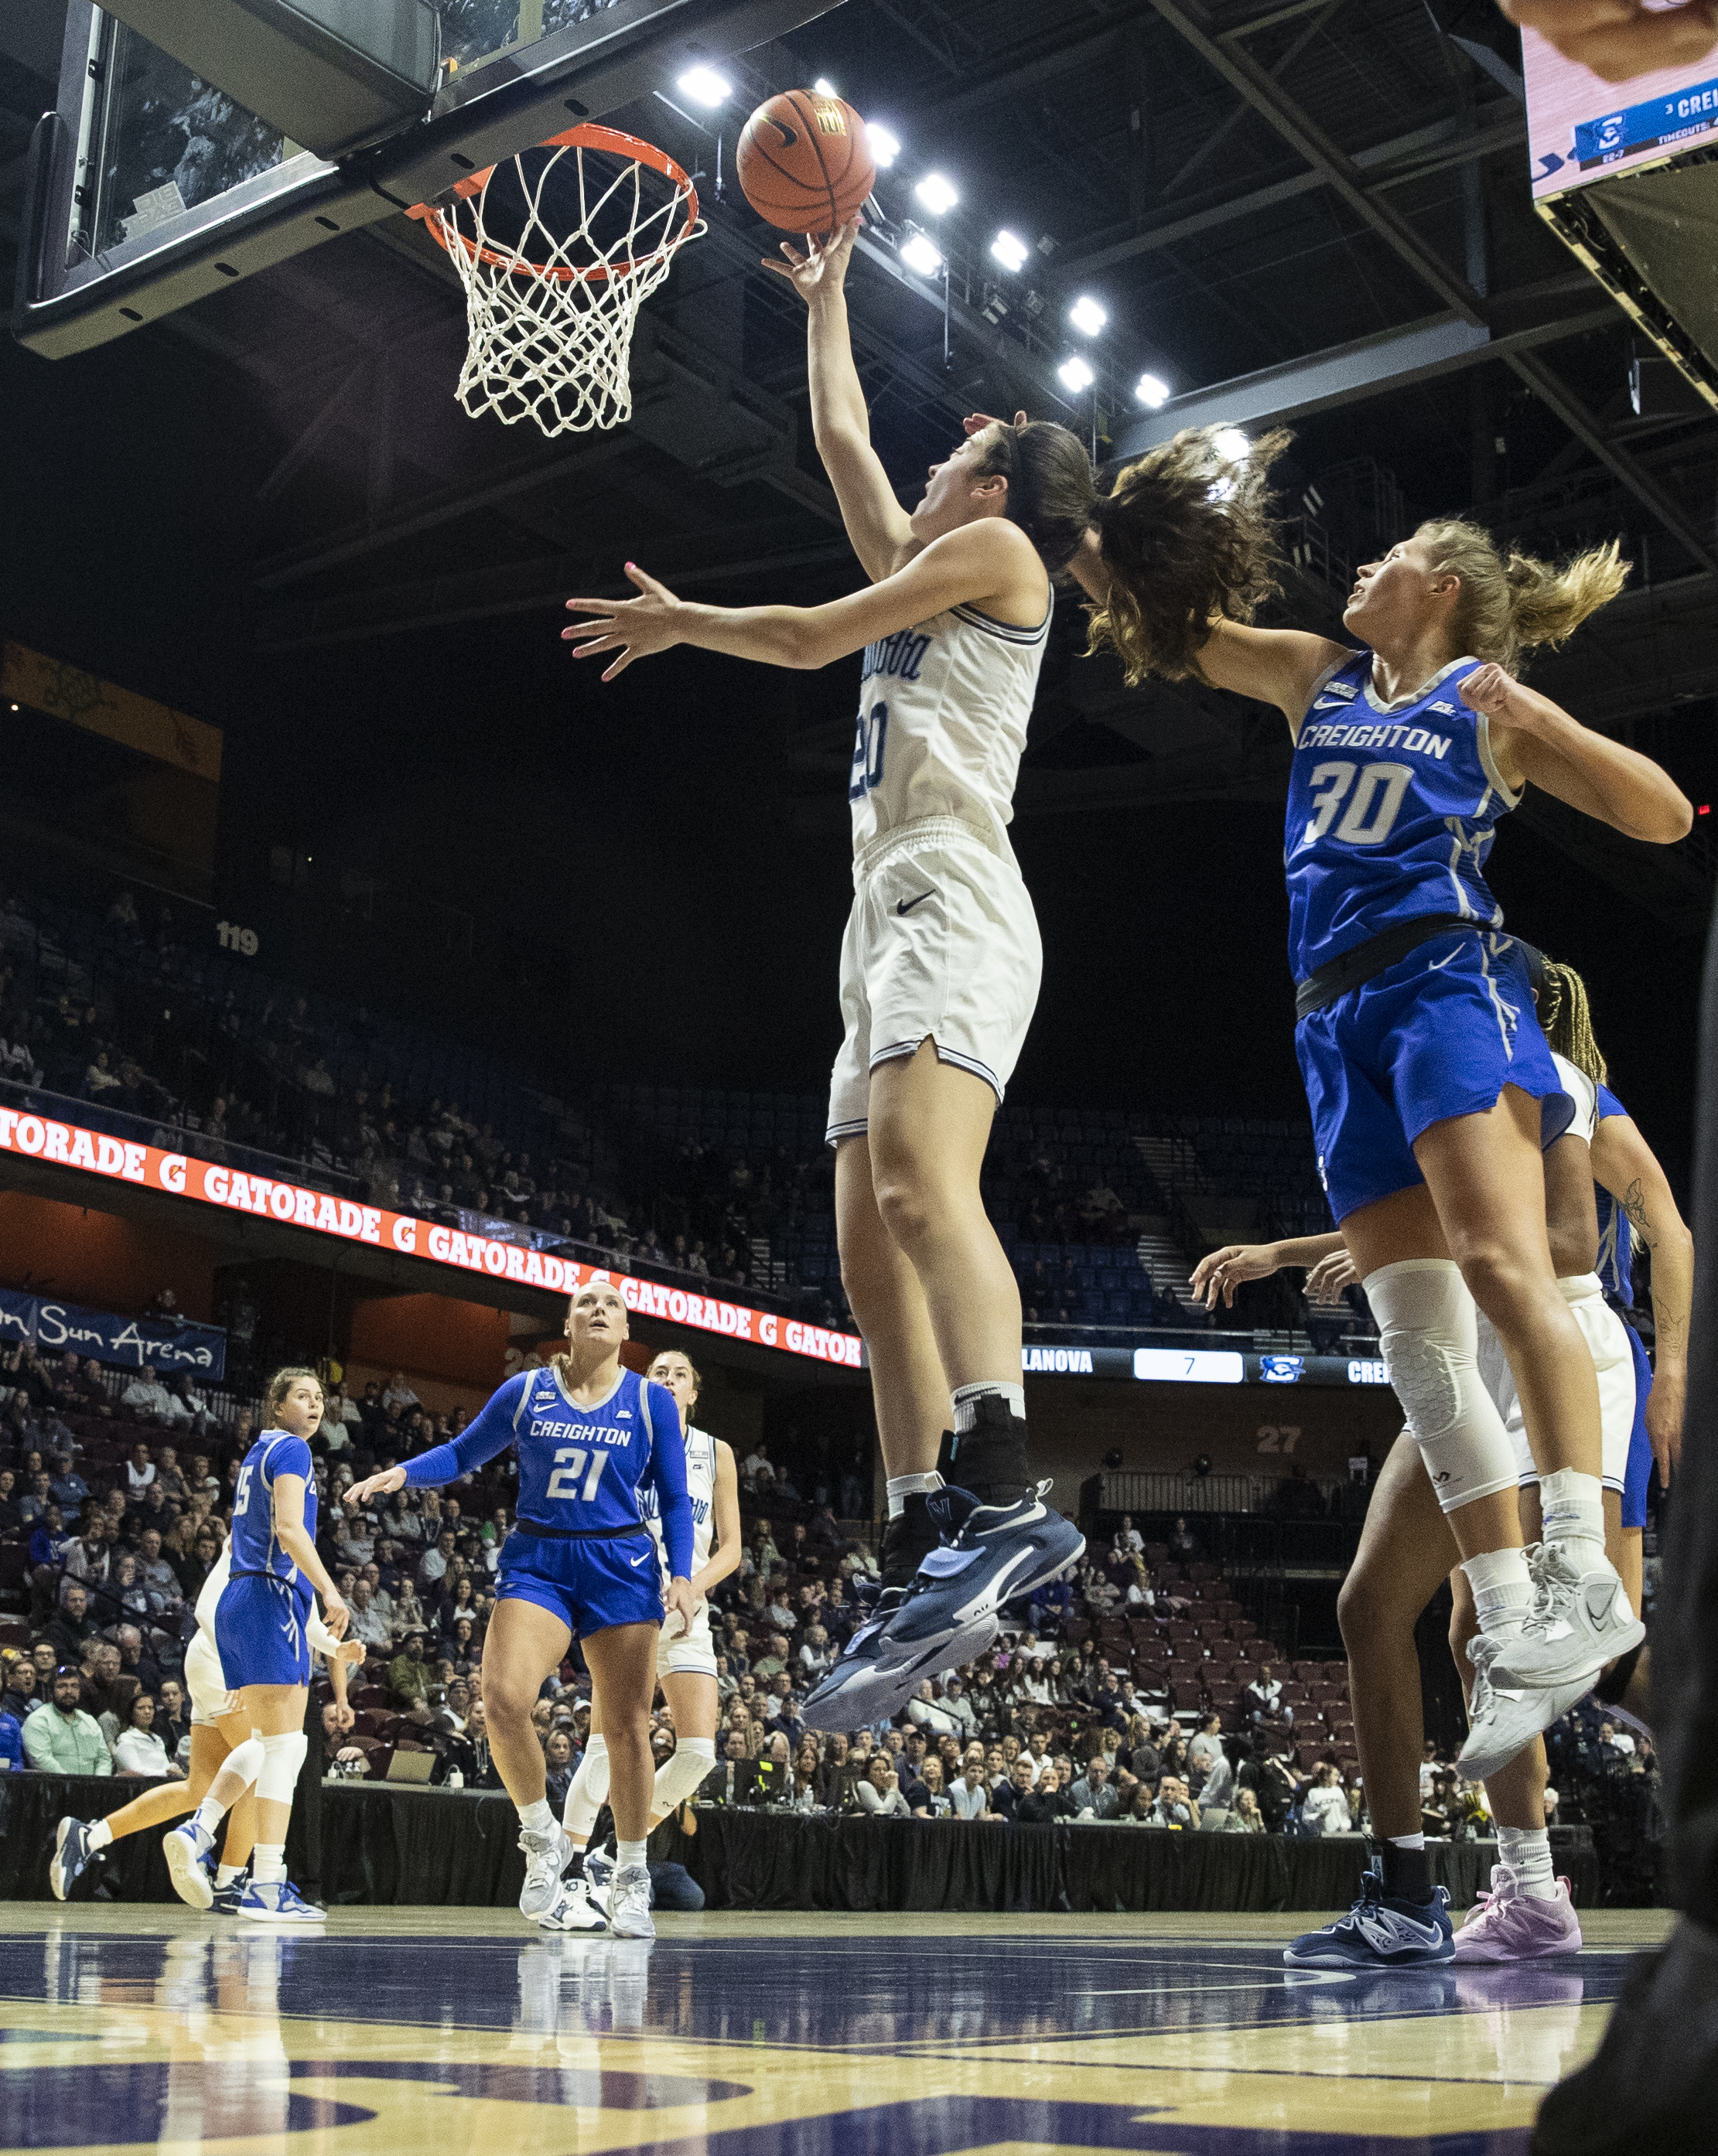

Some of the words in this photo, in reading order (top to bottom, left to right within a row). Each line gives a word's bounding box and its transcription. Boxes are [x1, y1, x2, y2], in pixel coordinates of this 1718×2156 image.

[1665, 103, 1674, 115] 3
[1297, 725, 1453, 759] CREIGHTON
[1303, 760, 1416, 844] 30
[217, 920, 259, 956] 119
[0, 1108, 147, 1182] TORADE
[159, 1153, 187, 1193] G
[203, 1166, 381, 1243] GATORADE
[392, 1216, 416, 1253] G
[428, 1226, 581, 1295] GATORADE
[619, 1277, 752, 1339] GATORADE
[759, 1314, 778, 1346] G
[785, 1319, 862, 1367] GATOR
[0, 1308, 29, 1336] n
[39, 1305, 104, 1348] Sun
[110, 1322, 213, 1367] Arena
[1021, 1348, 1094, 1373] LANOVA
[1184, 1357, 1195, 1375] 7
[530, 1420, 631, 1448] CREIGHTON
[1256, 1425, 1301, 1454] 27
[545, 1447, 610, 1502] 21
